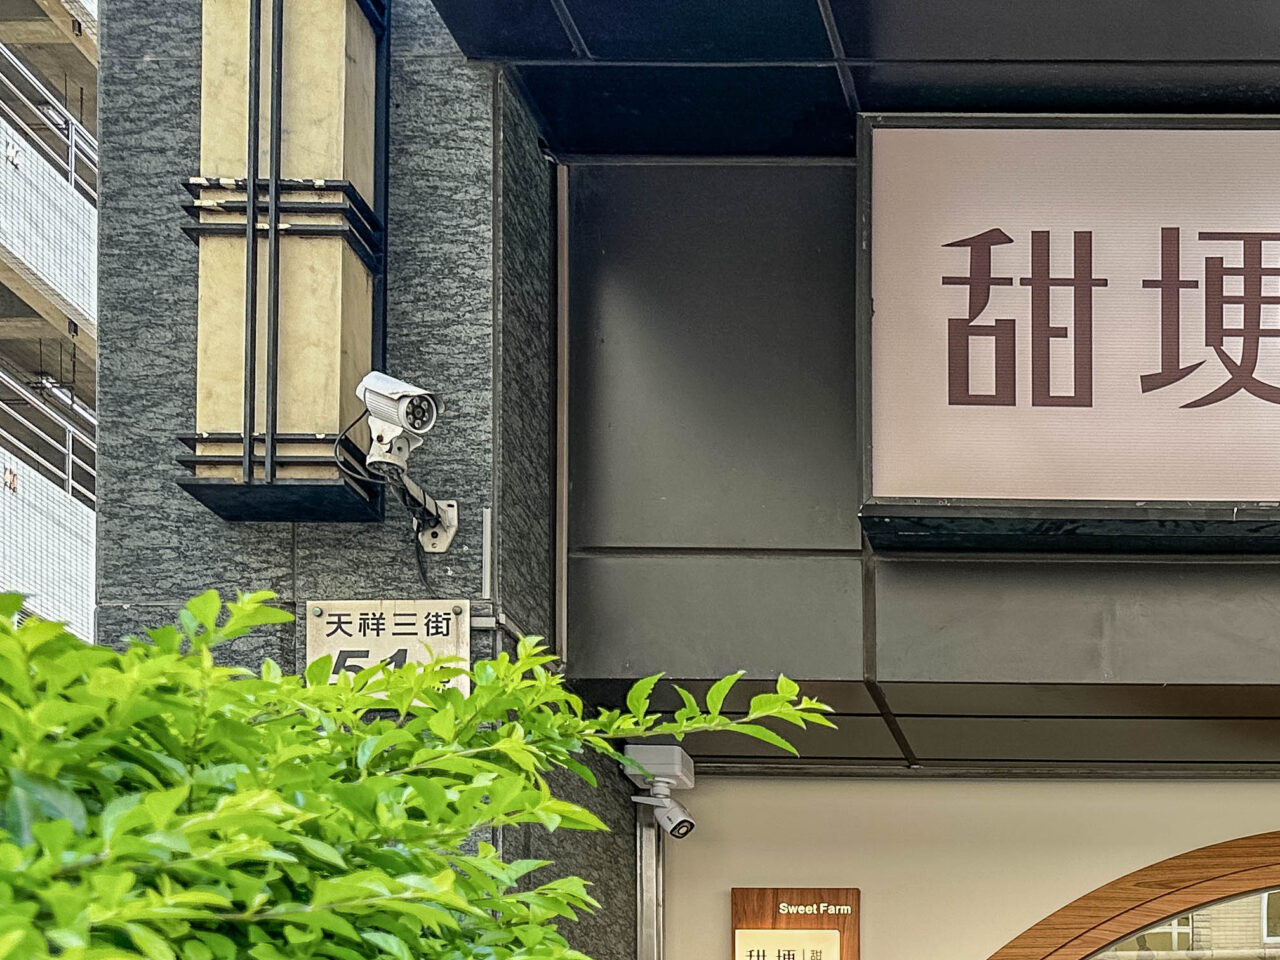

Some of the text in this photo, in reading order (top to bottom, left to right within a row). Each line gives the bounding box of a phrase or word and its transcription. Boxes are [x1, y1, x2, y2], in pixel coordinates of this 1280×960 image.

[325, 612, 452, 637] 天祥三街
[779, 903, 851, 914] Sweet Farm
